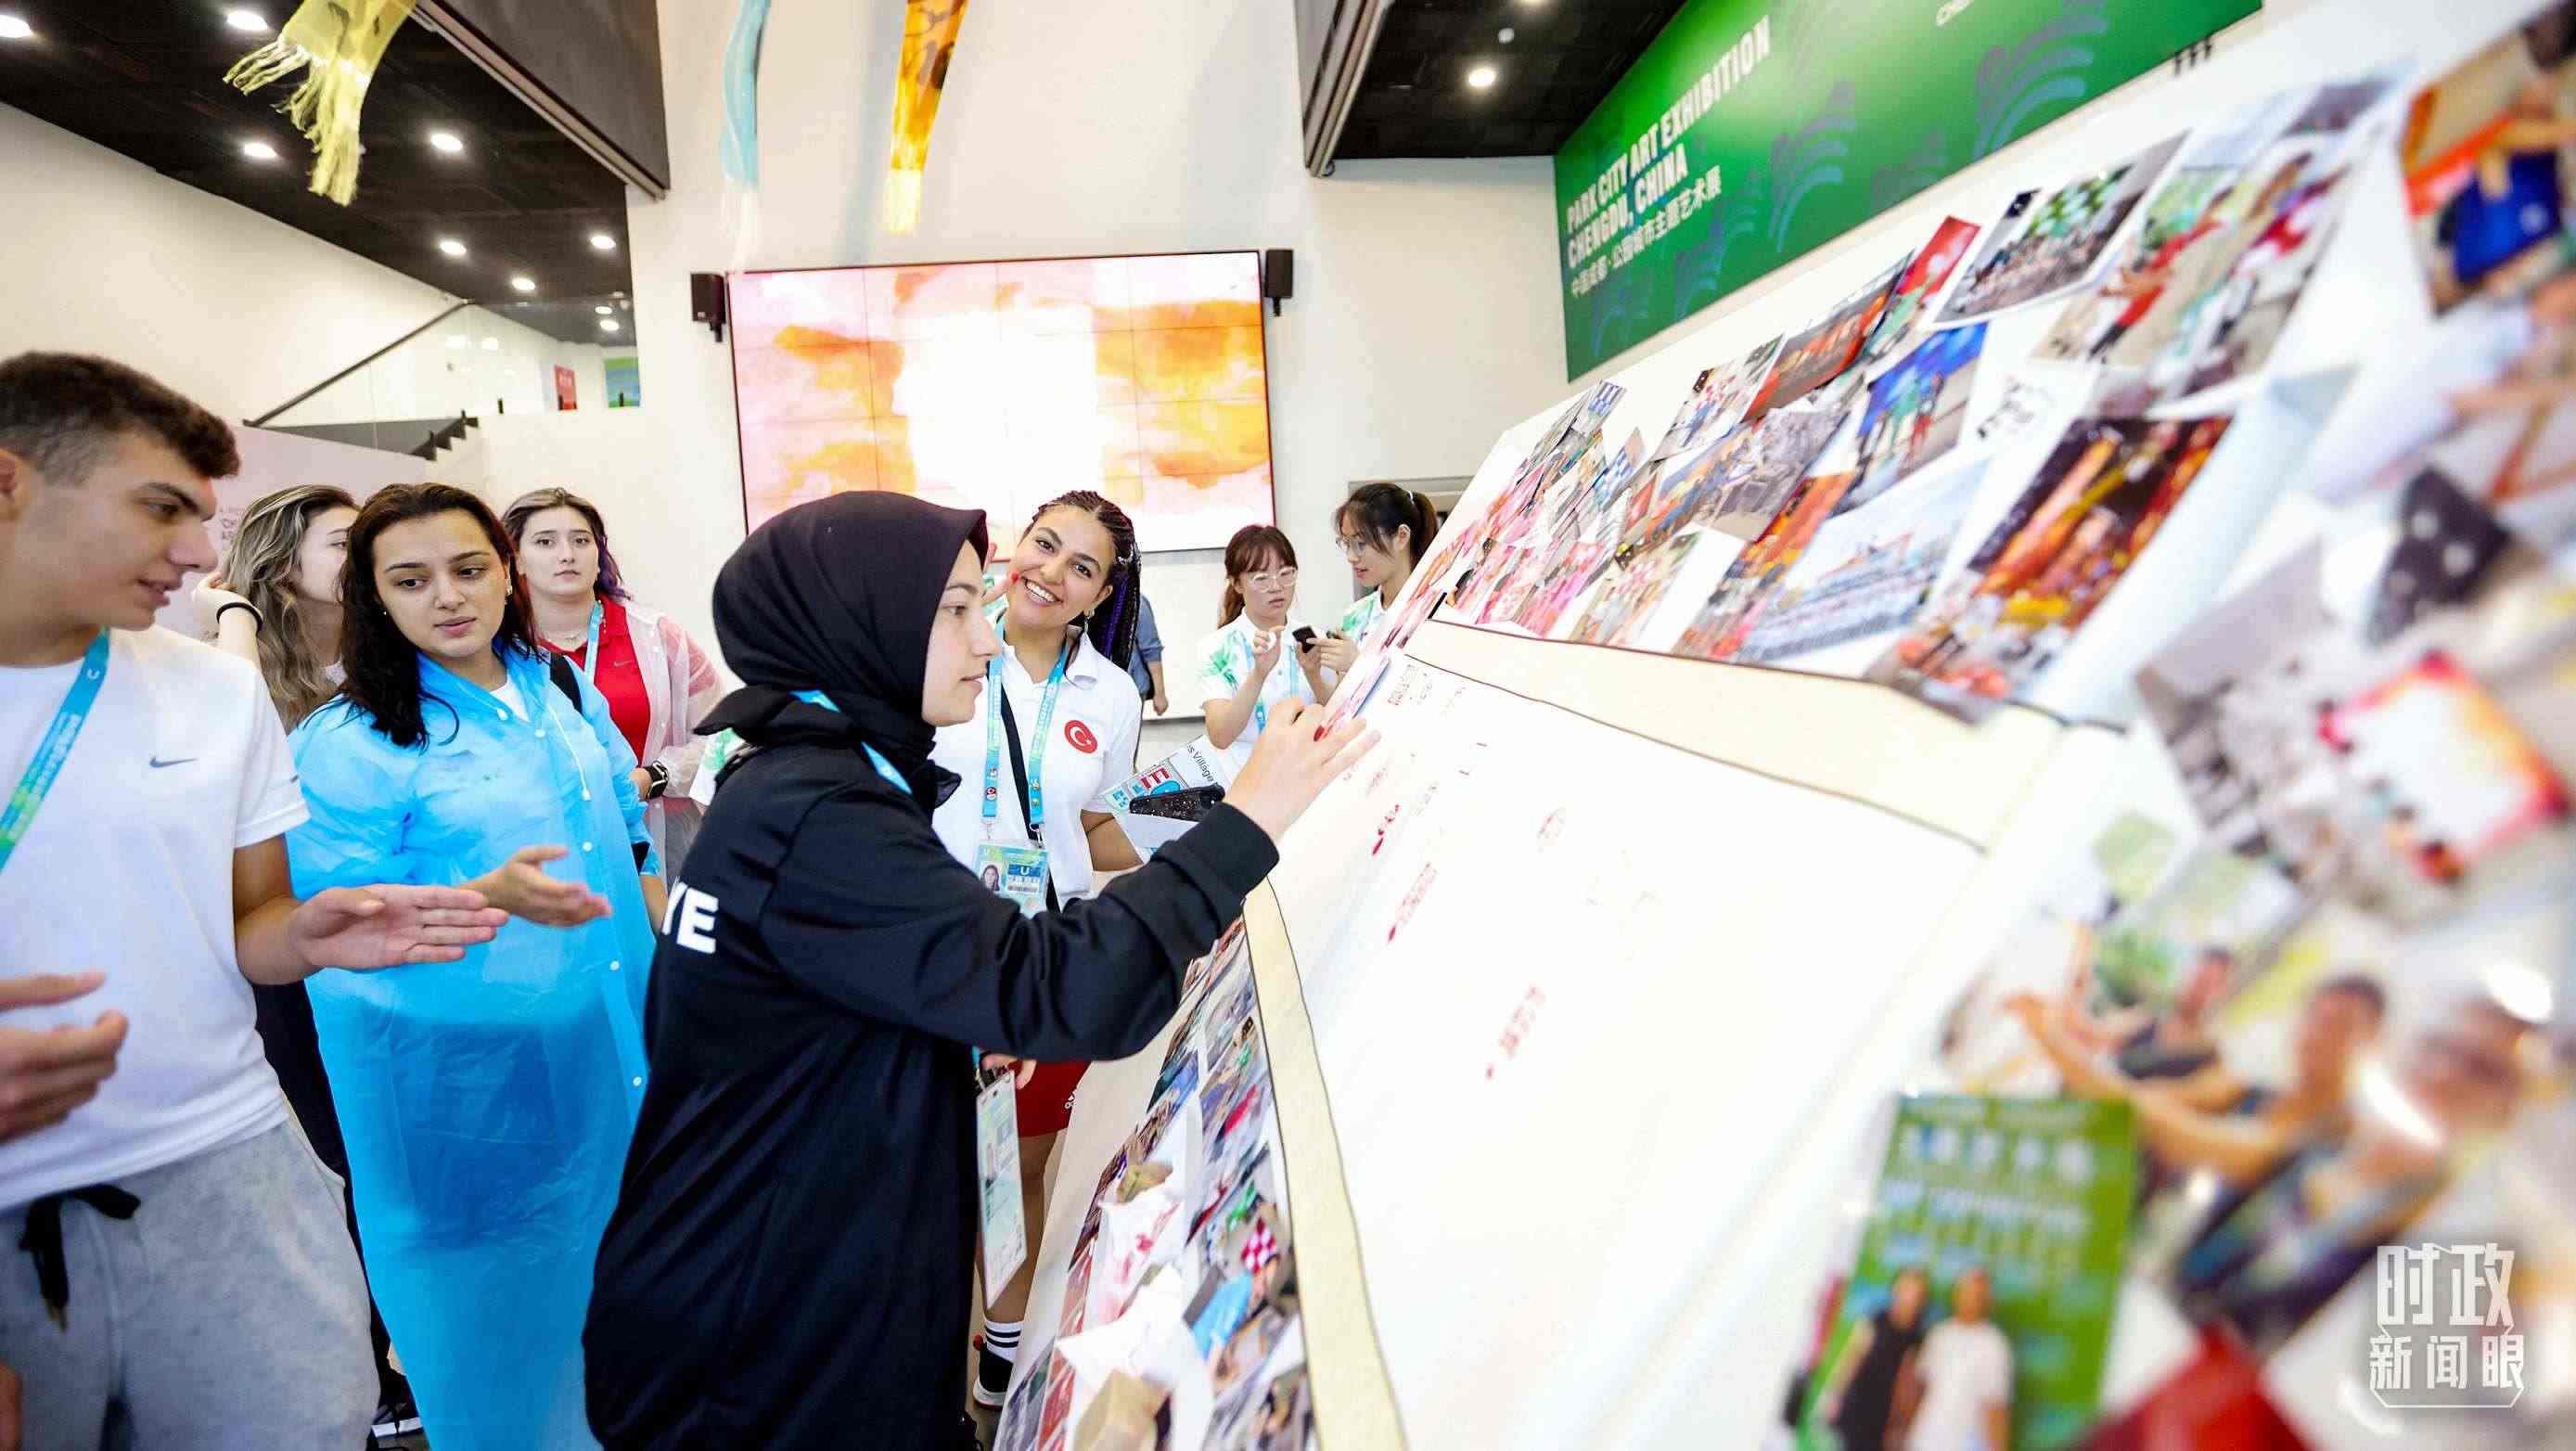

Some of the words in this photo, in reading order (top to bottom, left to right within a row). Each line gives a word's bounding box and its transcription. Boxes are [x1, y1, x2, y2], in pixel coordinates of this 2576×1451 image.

[1567, 183, 1597, 234] PARK
[1596, 153, 1628, 207] CITY
[1630, 122, 1659, 179] ART
[1660, 14, 1770, 149] EXHIBITION
[1568, 193, 1634, 268] CHENGDU,
[1634, 143, 1687, 214] CHINA
[1193, 751, 1215, 782] Village
